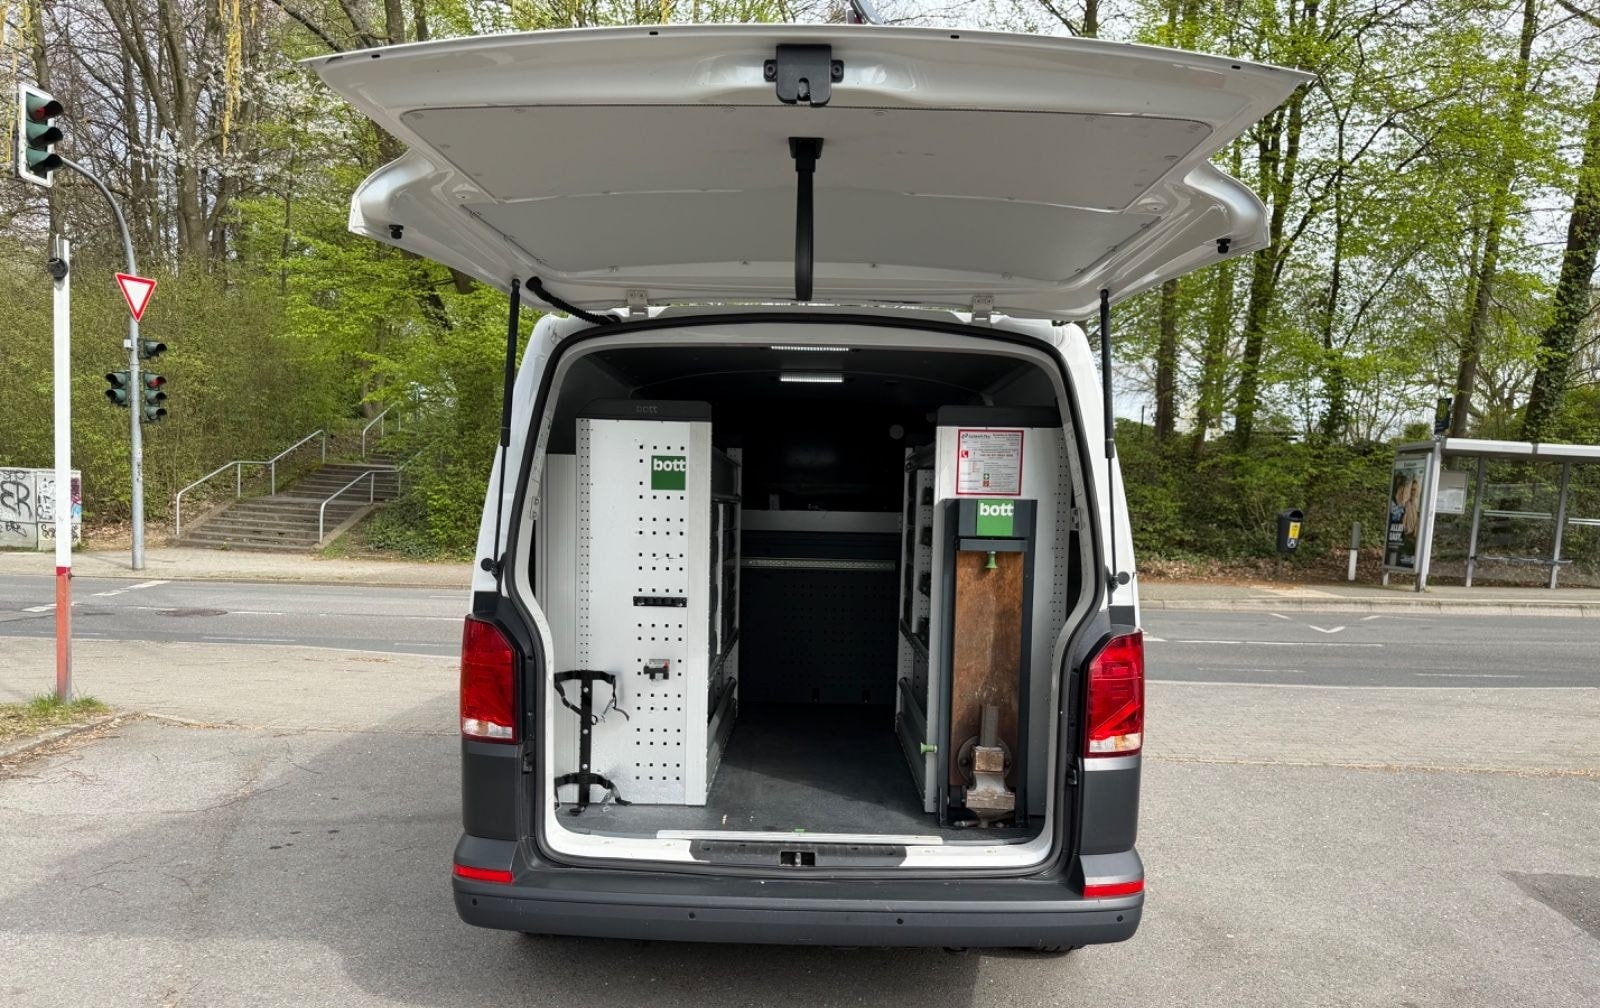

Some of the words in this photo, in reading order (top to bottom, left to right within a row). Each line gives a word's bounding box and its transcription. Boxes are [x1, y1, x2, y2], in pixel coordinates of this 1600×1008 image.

[636, 405, 658, 414] bott
[653, 458, 687, 472] bott
[980, 502, 1014, 517] bott
